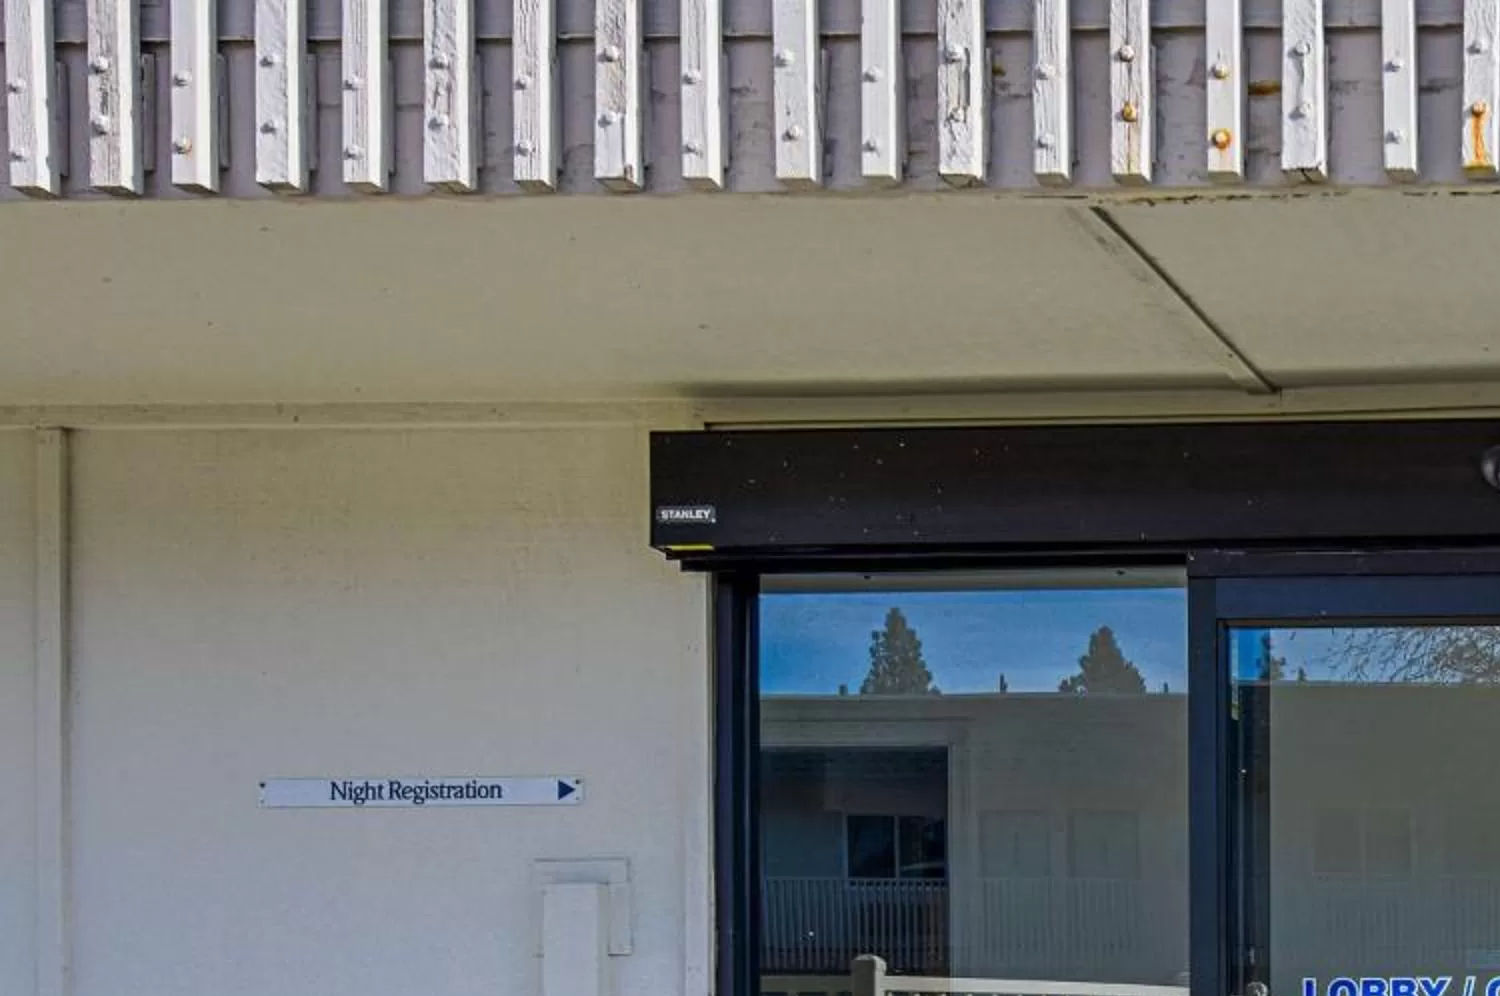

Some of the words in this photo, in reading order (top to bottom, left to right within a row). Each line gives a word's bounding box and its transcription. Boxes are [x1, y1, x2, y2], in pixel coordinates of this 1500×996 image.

[661, 509, 711, 519] STANLEY
[331, 781, 384, 805] Night
[388, 780, 503, 805] Registration
